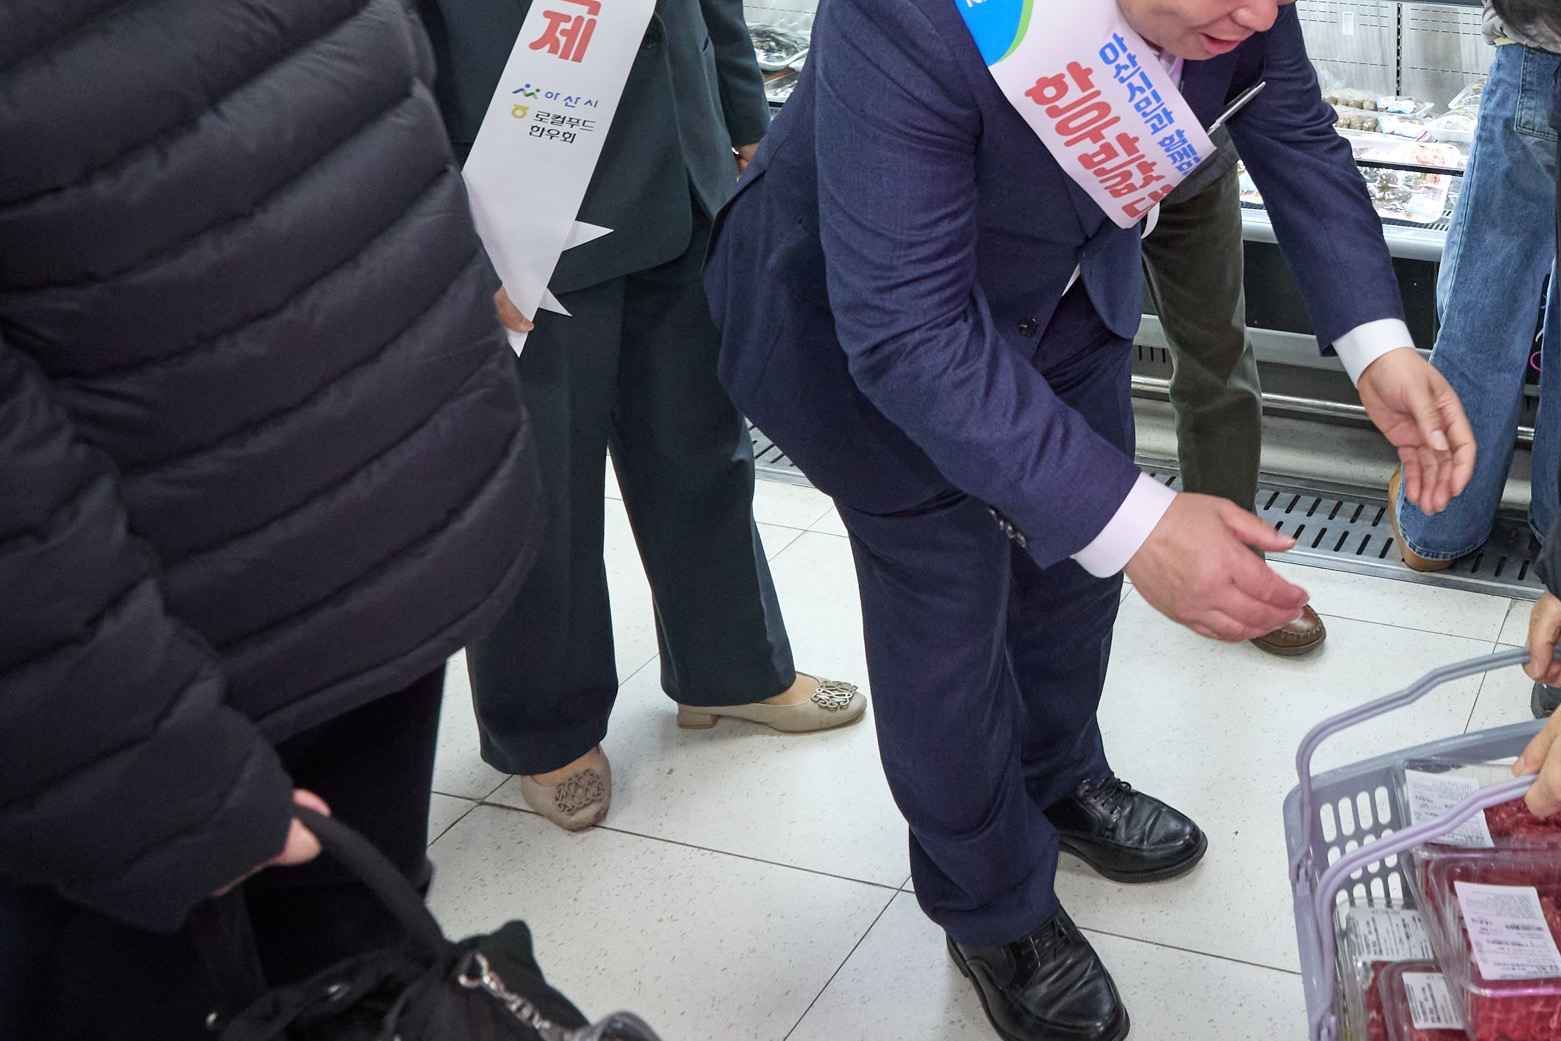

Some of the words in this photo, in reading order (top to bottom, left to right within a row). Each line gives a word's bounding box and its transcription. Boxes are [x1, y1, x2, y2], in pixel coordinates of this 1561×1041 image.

[544, 91, 598, 109] 아산시
[1100, 32, 1175, 137] 아산시민과
[533, 110, 596, 132] 로컬푸드
[1024, 61, 1166, 200] 한우반값
